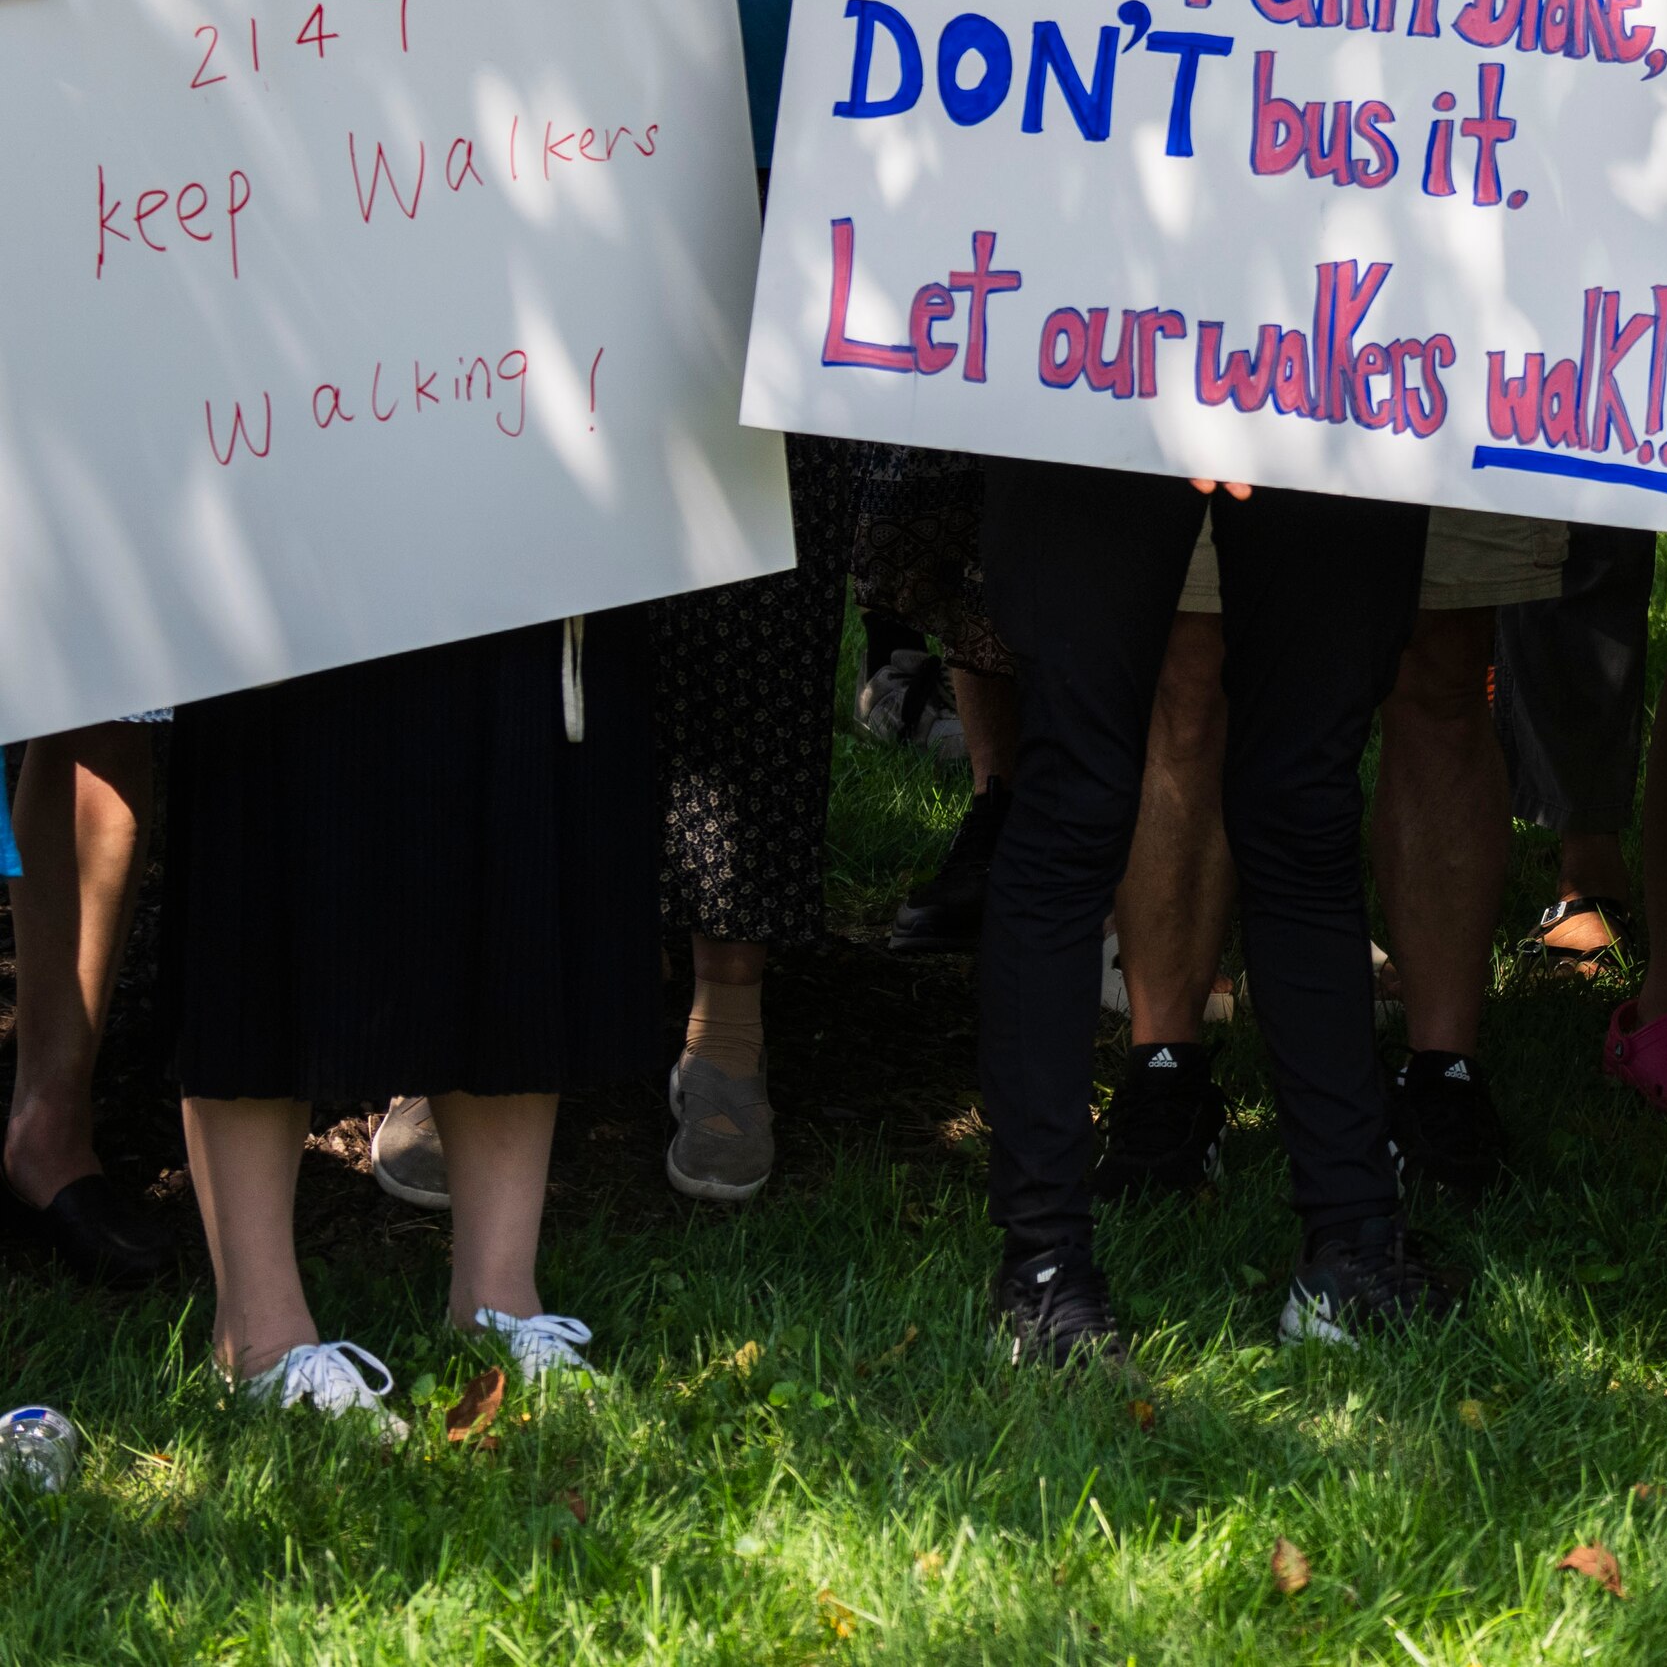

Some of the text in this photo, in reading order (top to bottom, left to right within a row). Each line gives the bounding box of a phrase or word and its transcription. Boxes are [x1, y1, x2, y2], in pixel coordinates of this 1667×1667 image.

[96, 116, 661, 280] keep Walkers
[1250, 50, 1398, 189] bus
[1421, 61, 1529, 211] it.
[820, 216, 1022, 384] Let
[1037, 303, 1187, 400] our
[1148, 1060, 1178, 1068] adidas
